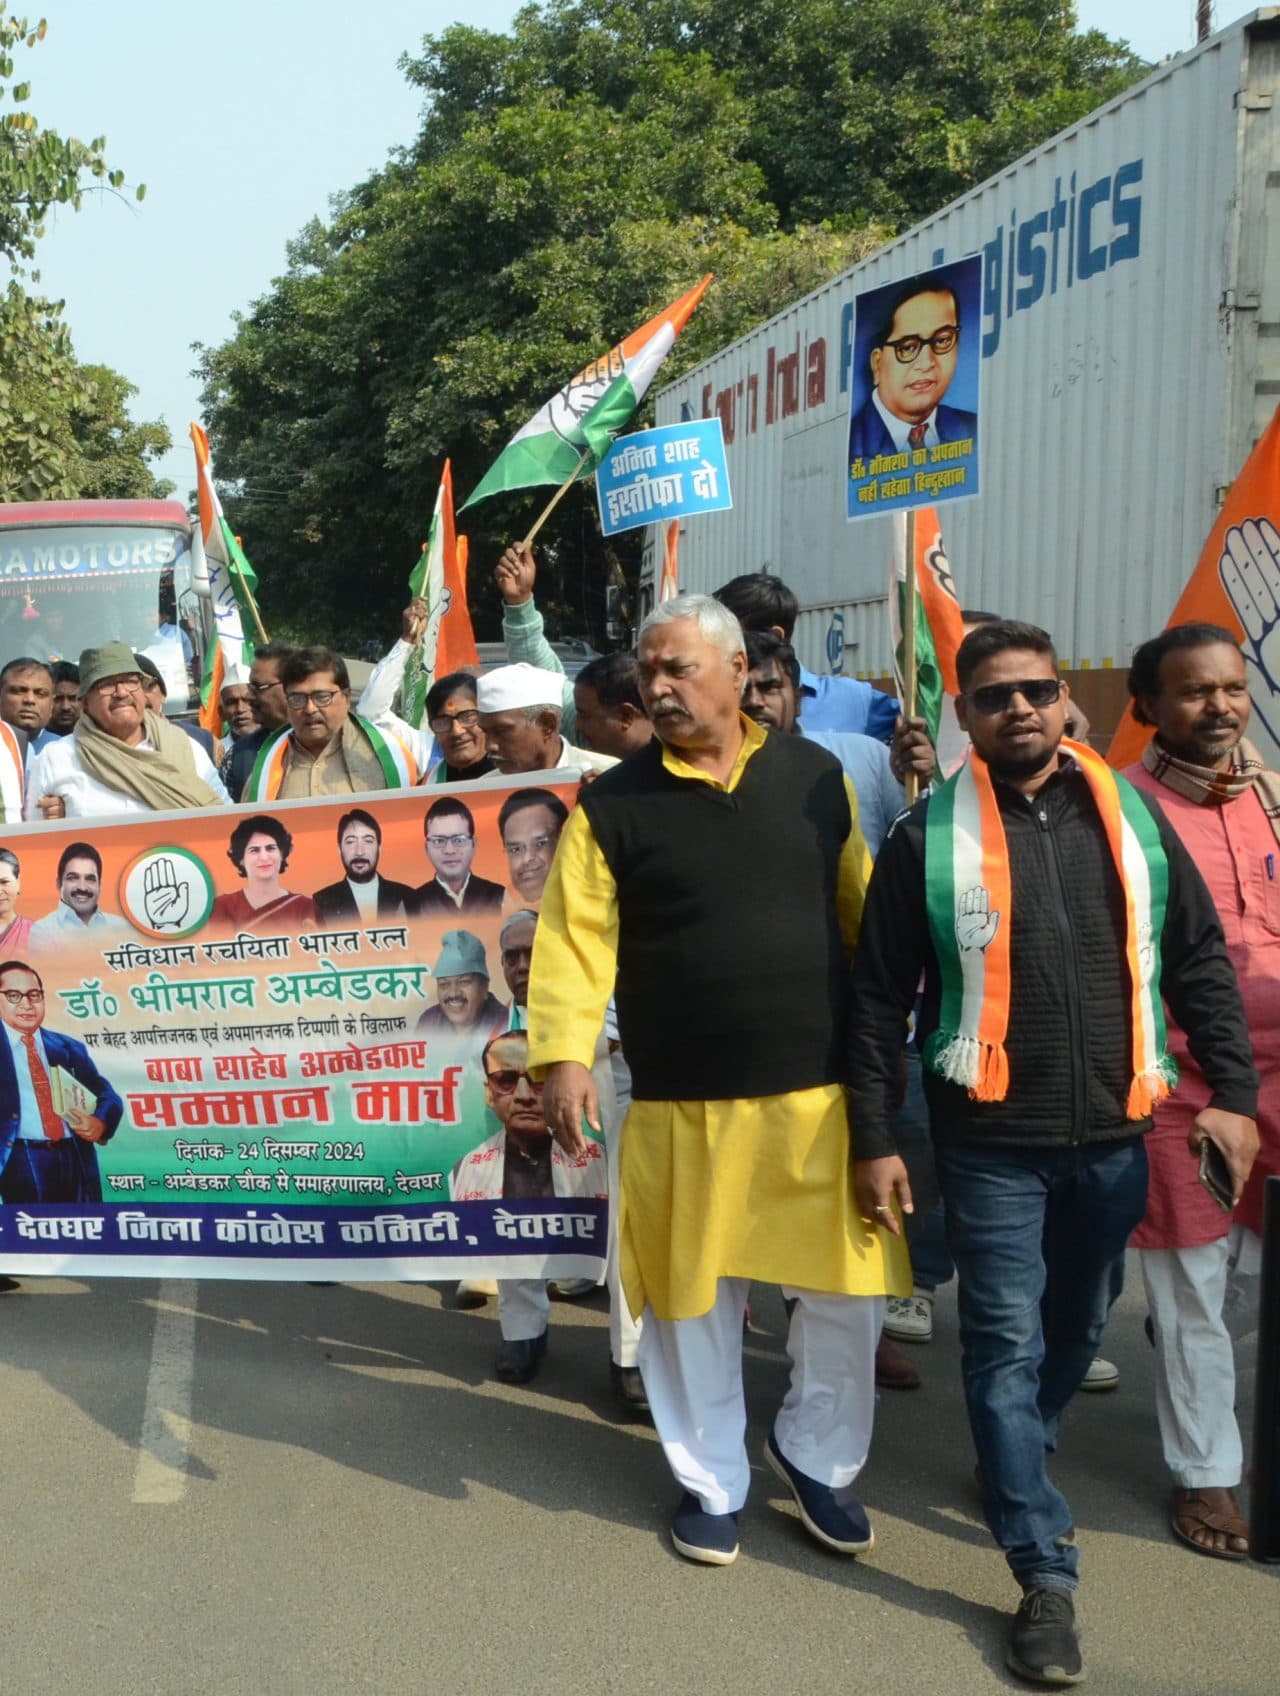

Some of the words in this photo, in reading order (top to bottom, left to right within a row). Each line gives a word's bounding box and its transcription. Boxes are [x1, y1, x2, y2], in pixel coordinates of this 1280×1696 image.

[933, 159, 1143, 359] gistics
[611, 445, 657, 478] अमित
[664, 437, 701, 463] शाह
[606, 473, 684, 527] इस्तीफा
[691, 459, 719, 499] दो
[104, 942, 196, 971] संविधान
[202, 933, 290, 963] रचयिता
[299, 930, 360, 955] भारत
[366, 926, 408, 950] रत्न
[130, 973, 255, 1014] भीमराव
[267, 959, 430, 1006] अम्बेडकर
[84, 1034, 100, 1048] पर
[103, 1028, 128, 1049] बेहद
[130, 1026, 198, 1046] आपत्तिजनक
[222, 1022, 295, 1041] अपमानजनक
[297, 1015, 340, 1038] टिप्पणी
[343, 1015, 358, 1036] के
[144, 1057, 203, 1083] बाबा
[213, 1047, 289, 1081] साहेब
[299, 1041, 428, 1078] अम्बेडकर
[127, 1086, 329, 1127] सम्मान
[352, 1066, 463, 1123] मार्च
[239, 1143, 259, 1159] 24
[263, 1138, 319, 1160] दिसम्बर
[324, 1143, 365, 1160] 2024
[108, 1175, 144, 1191] स्थान
[165, 1170, 231, 1191] अम्बेडकर
[235, 1168, 271, 1191] चौक
[275, 1172, 289, 1191] से
[396, 1170, 442, 1190] देवघर
[16, 1211, 105, 1241] देवघर
[116, 1211, 203, 1242] जिला
[214, 1211, 325, 1246] कांग्रेस
[492, 1208, 598, 1240] देवघर
